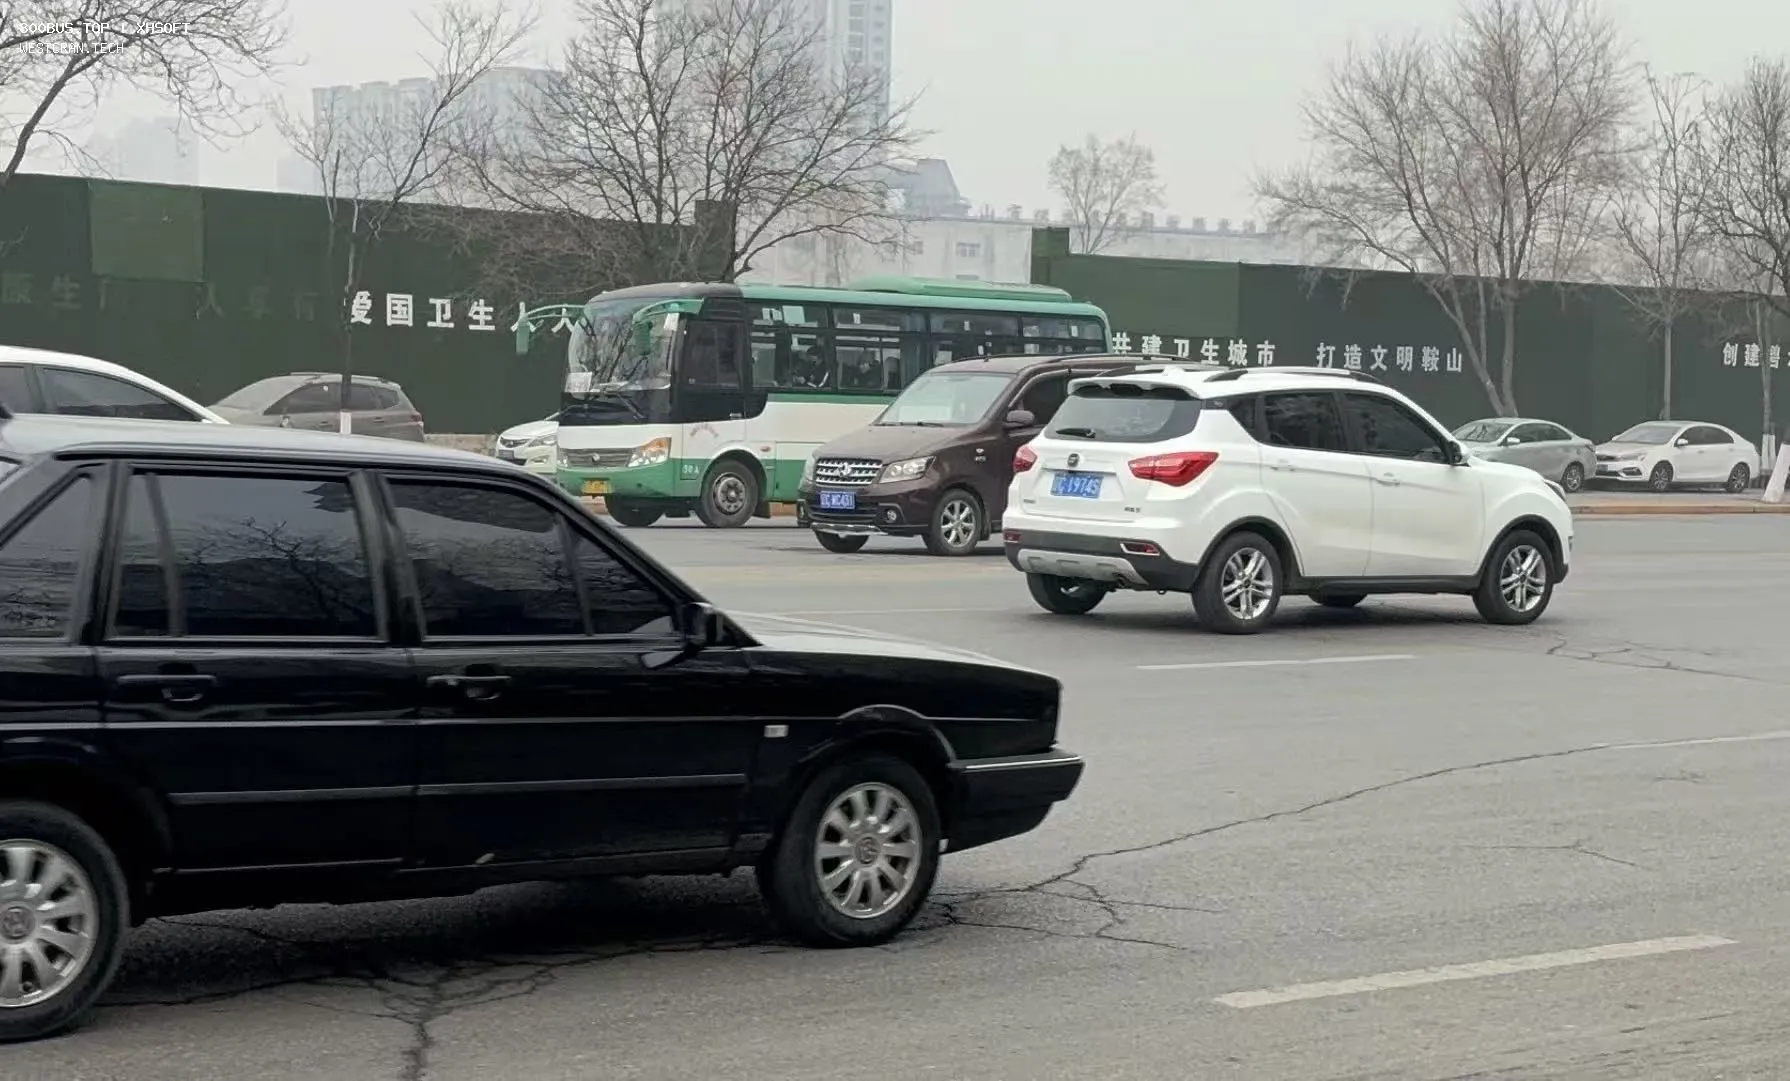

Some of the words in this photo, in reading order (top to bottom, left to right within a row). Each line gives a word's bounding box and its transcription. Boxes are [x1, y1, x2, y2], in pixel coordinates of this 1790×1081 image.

[1316, 342, 1463, 373] 打造文明鞍山
